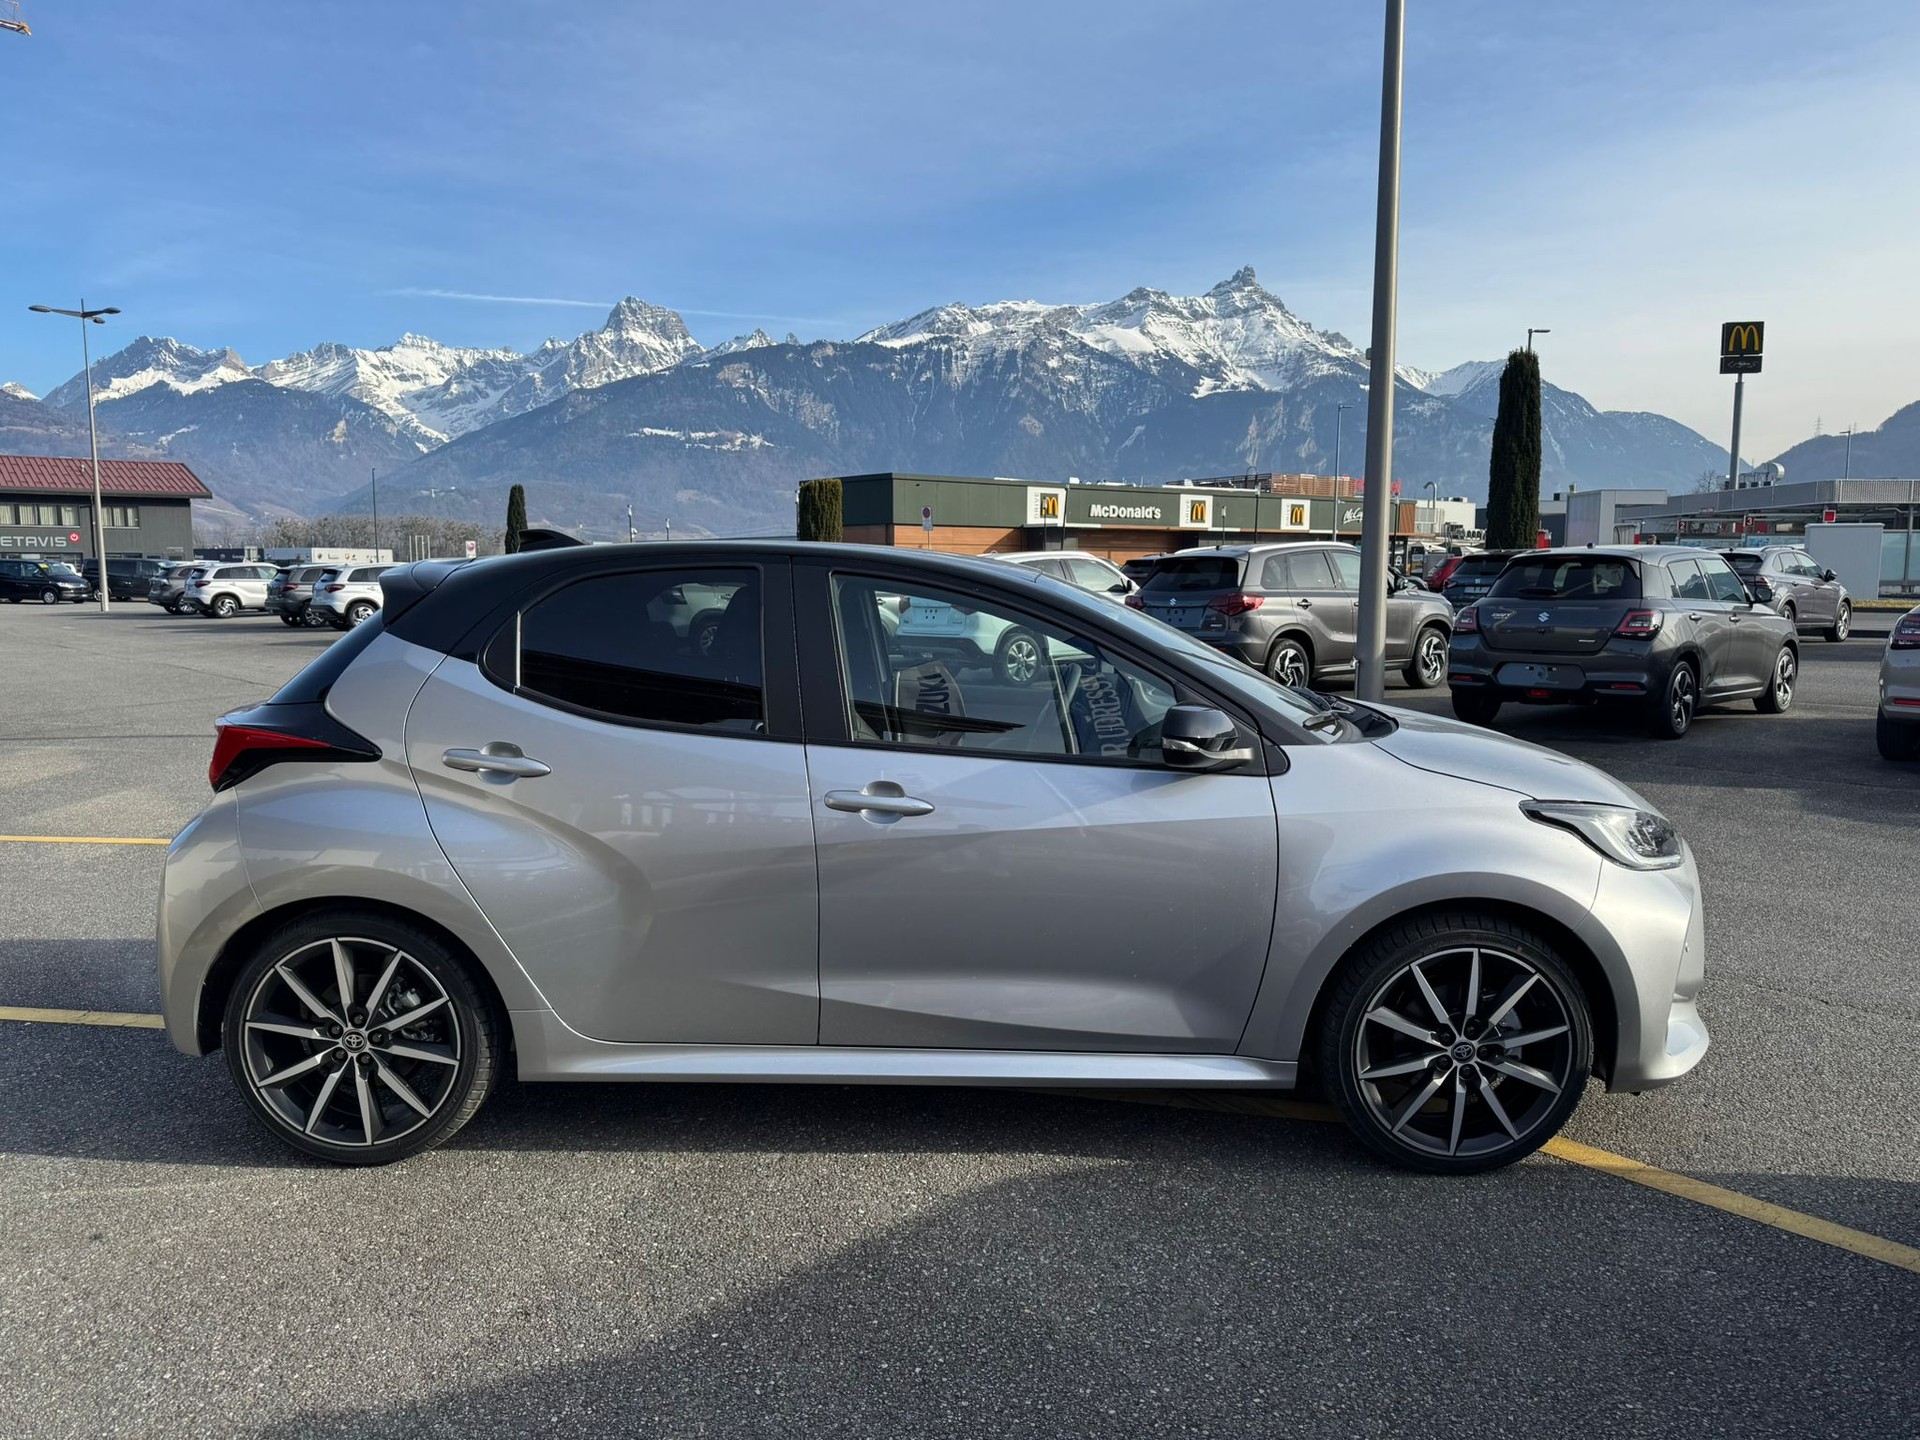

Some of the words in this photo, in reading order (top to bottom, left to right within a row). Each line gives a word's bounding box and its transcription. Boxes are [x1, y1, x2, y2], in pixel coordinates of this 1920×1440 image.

[1090, 504, 1161, 519] McDonald's
[1343, 507, 1364, 523] McCa
[0, 536, 67, 547] ETAVIS
